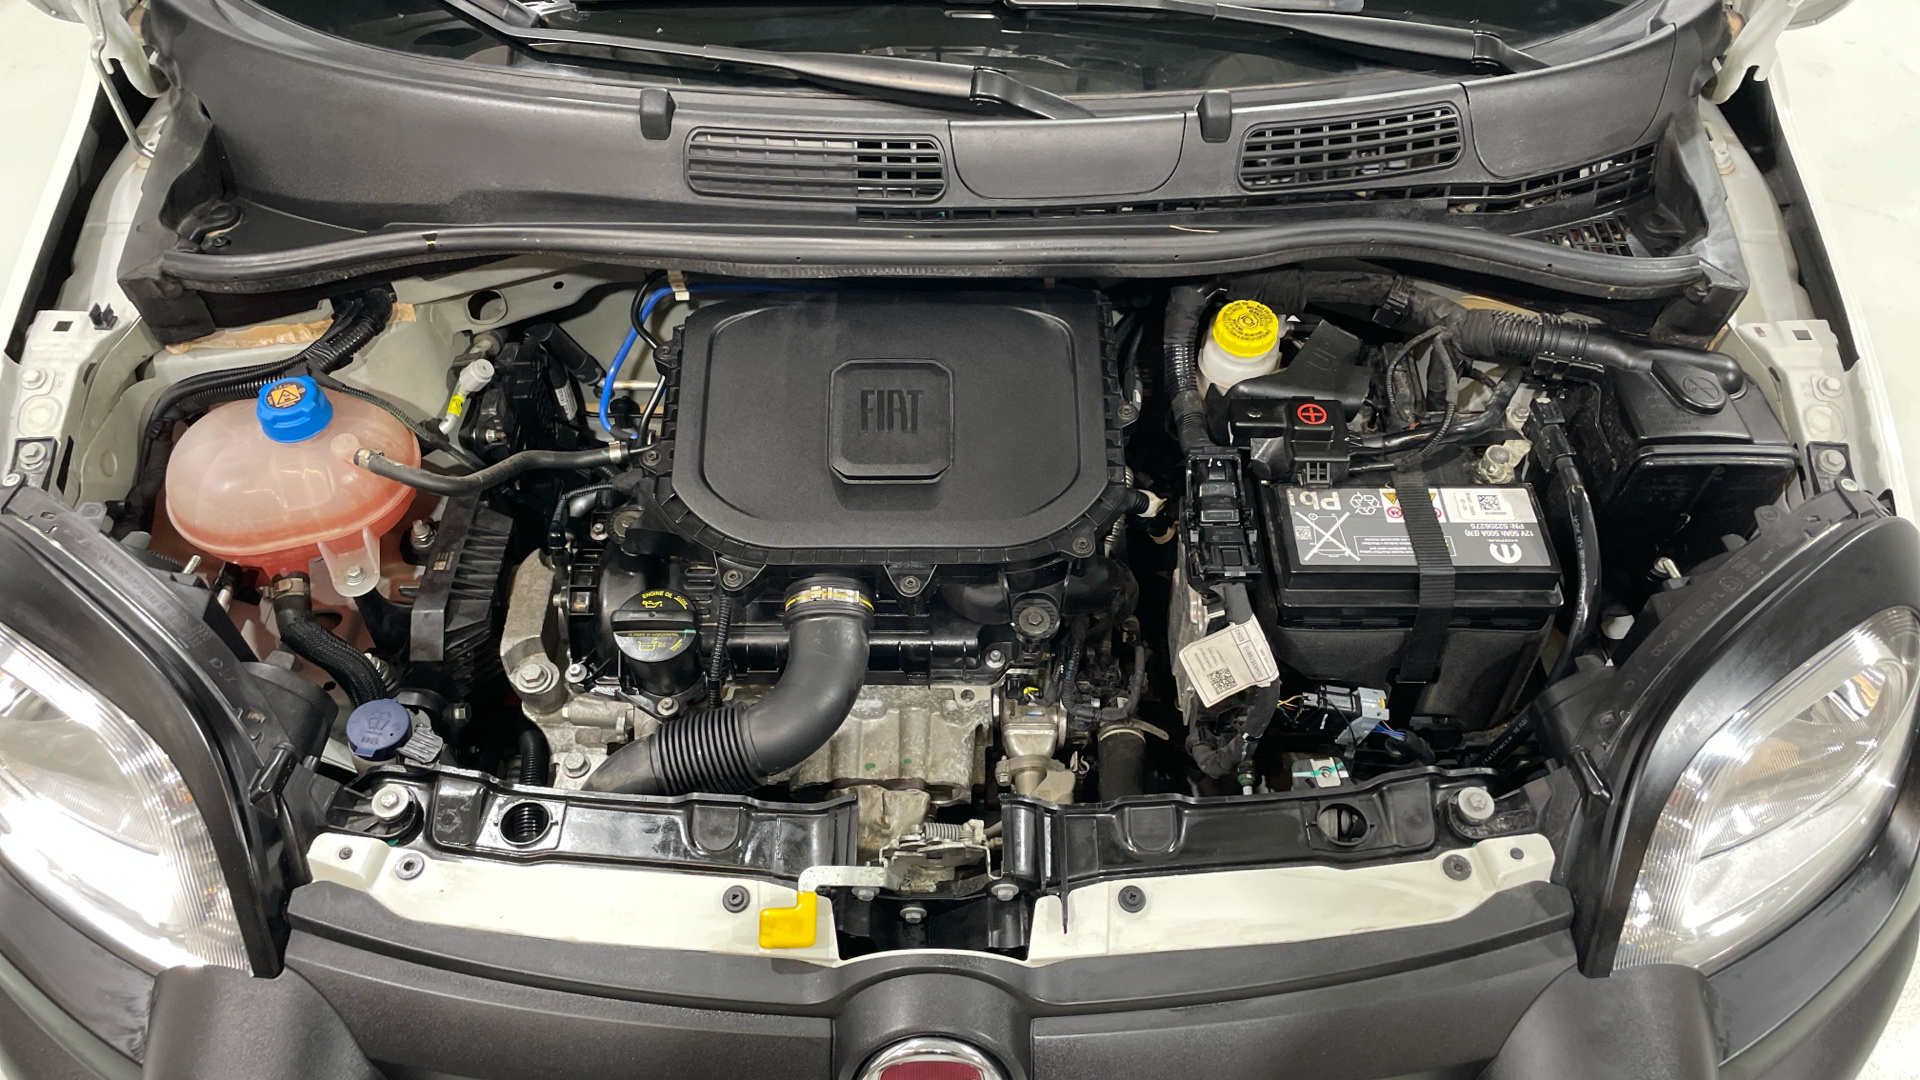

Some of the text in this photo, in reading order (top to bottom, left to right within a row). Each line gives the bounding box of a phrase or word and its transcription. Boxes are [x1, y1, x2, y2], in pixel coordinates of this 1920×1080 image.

[860, 389, 925, 434] FIAT
[1299, 491, 1342, 511] Pb
[1463, 528, 1479, 536] (EN)
[641, 590, 673, 599] ENGINE OIL
